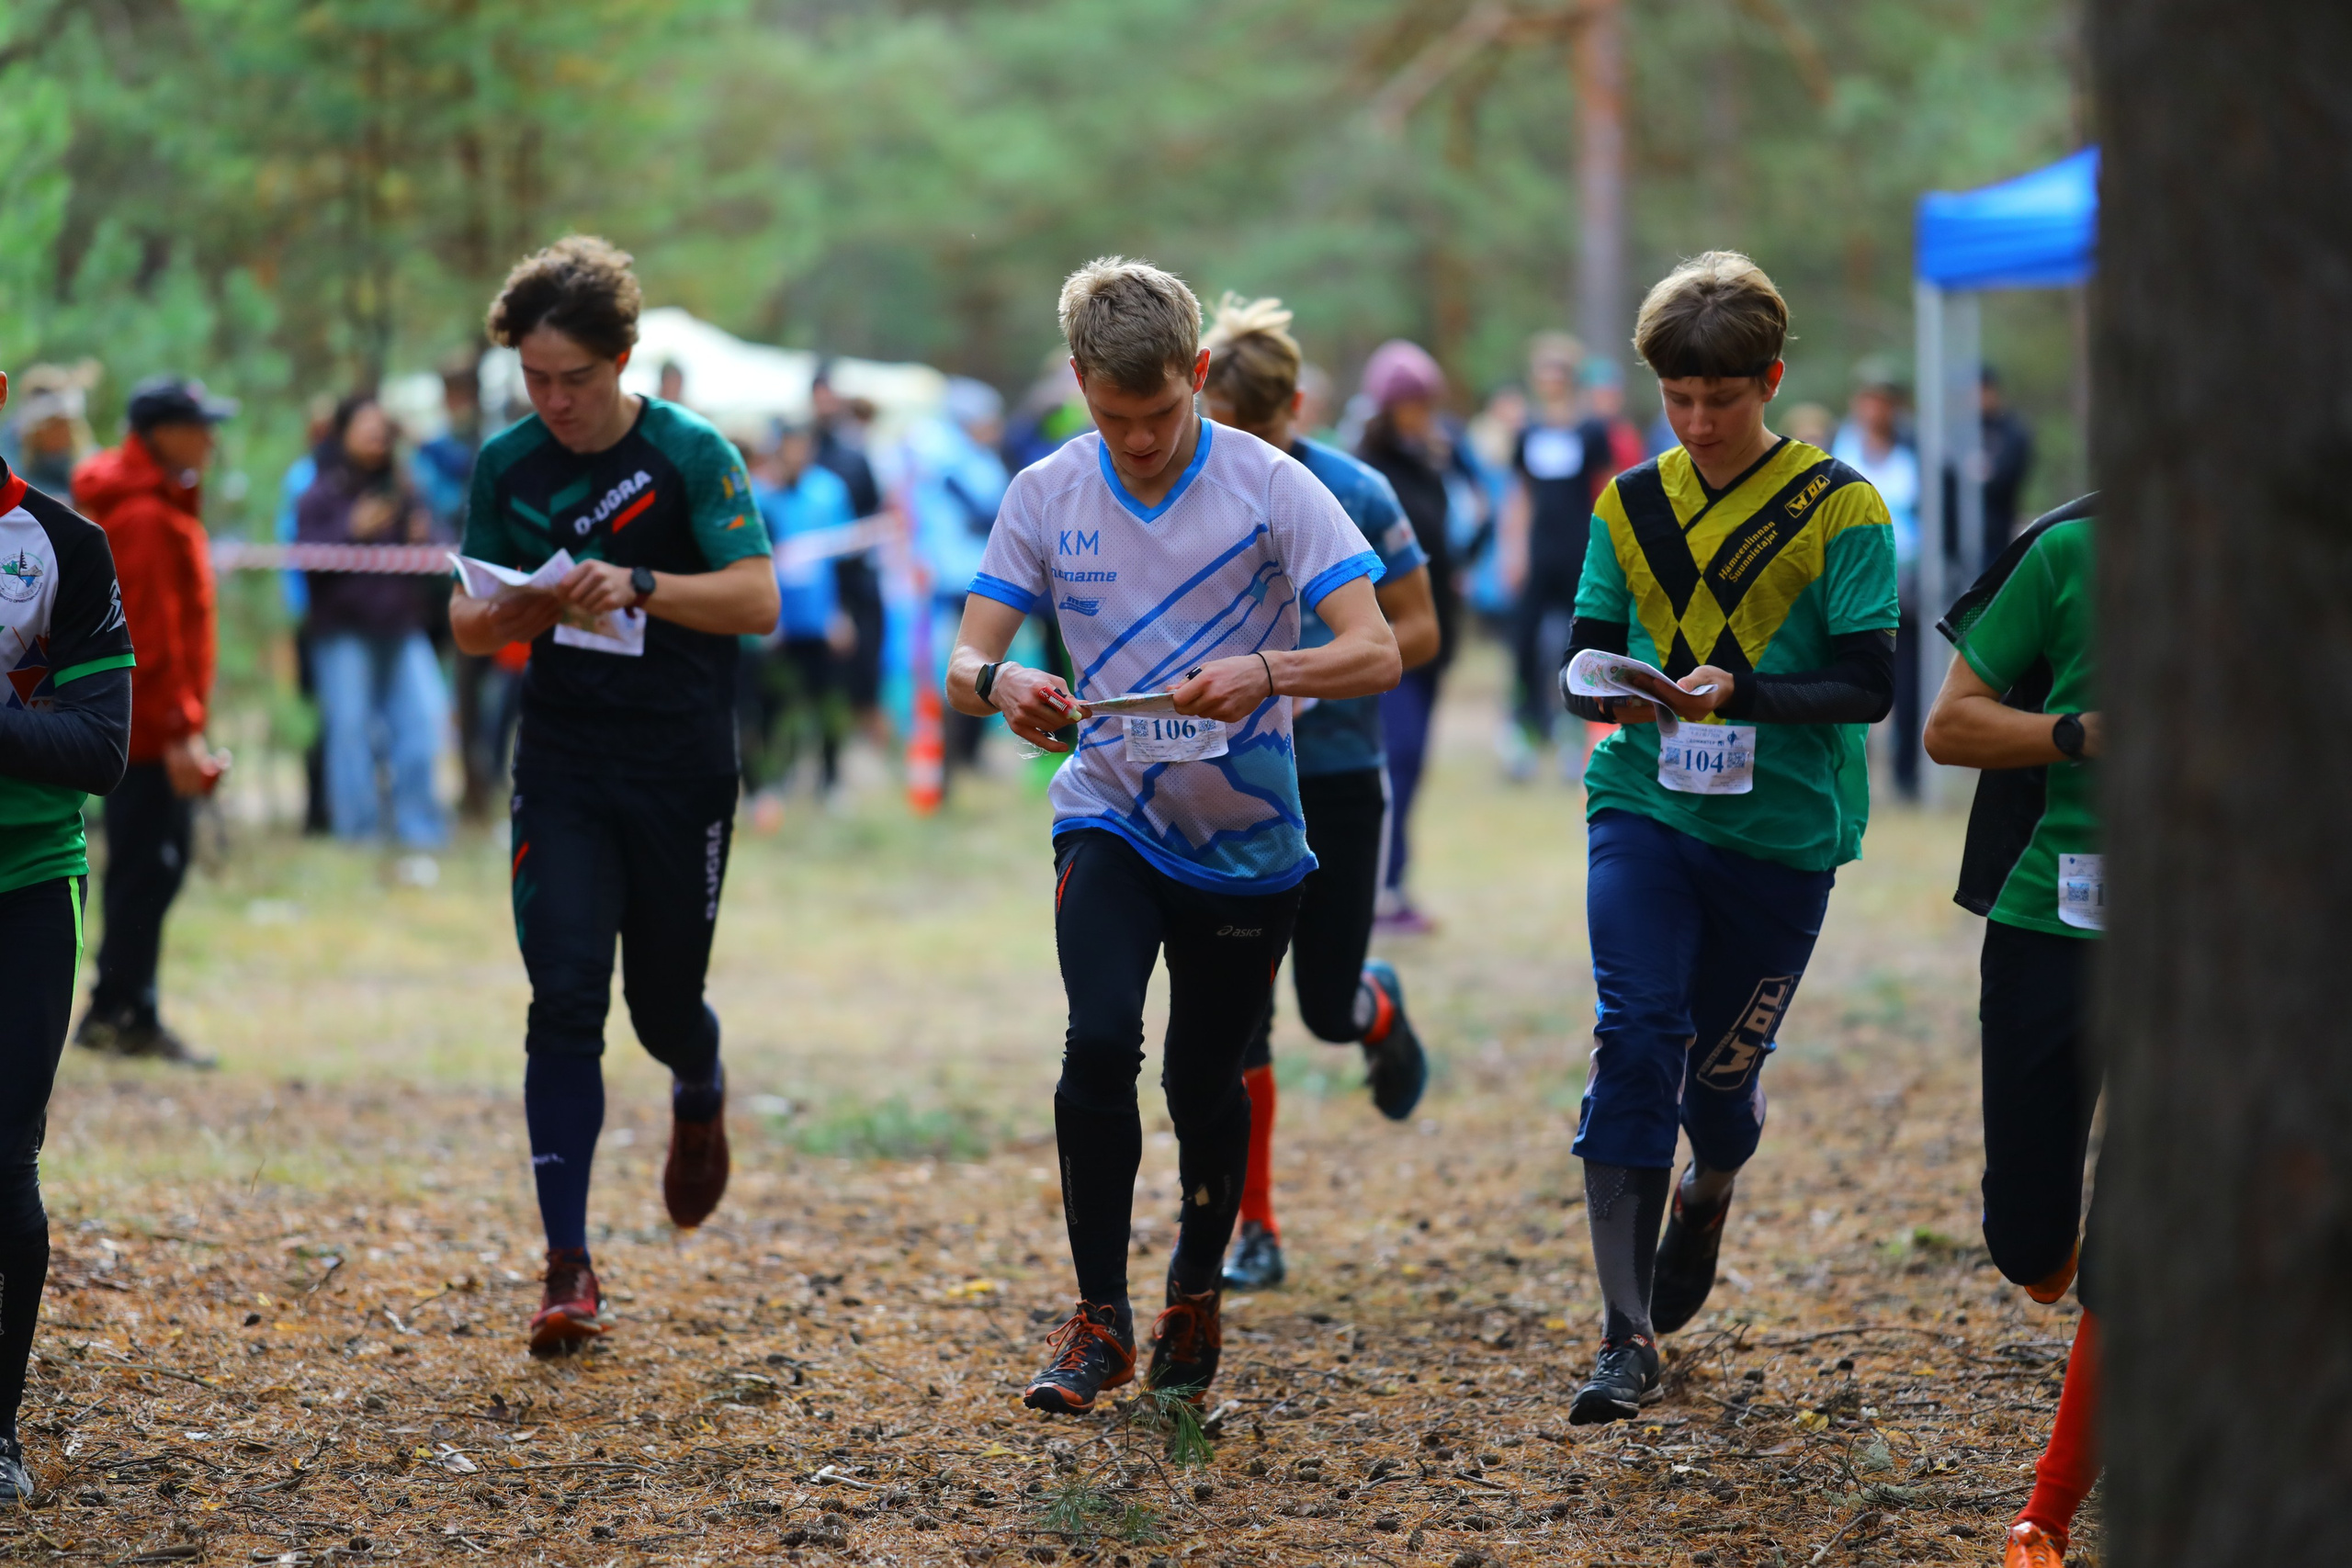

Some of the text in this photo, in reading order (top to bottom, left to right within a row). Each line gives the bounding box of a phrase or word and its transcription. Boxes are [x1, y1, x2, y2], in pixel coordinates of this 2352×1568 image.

[1058, 529, 1099, 556] KM
[1718, 520, 1777, 580] Hämeenlinnan
[1728, 529, 1779, 583] Suunnistajat
[1151, 718, 1196, 740] 106
[1684, 749, 1724, 773] 104
